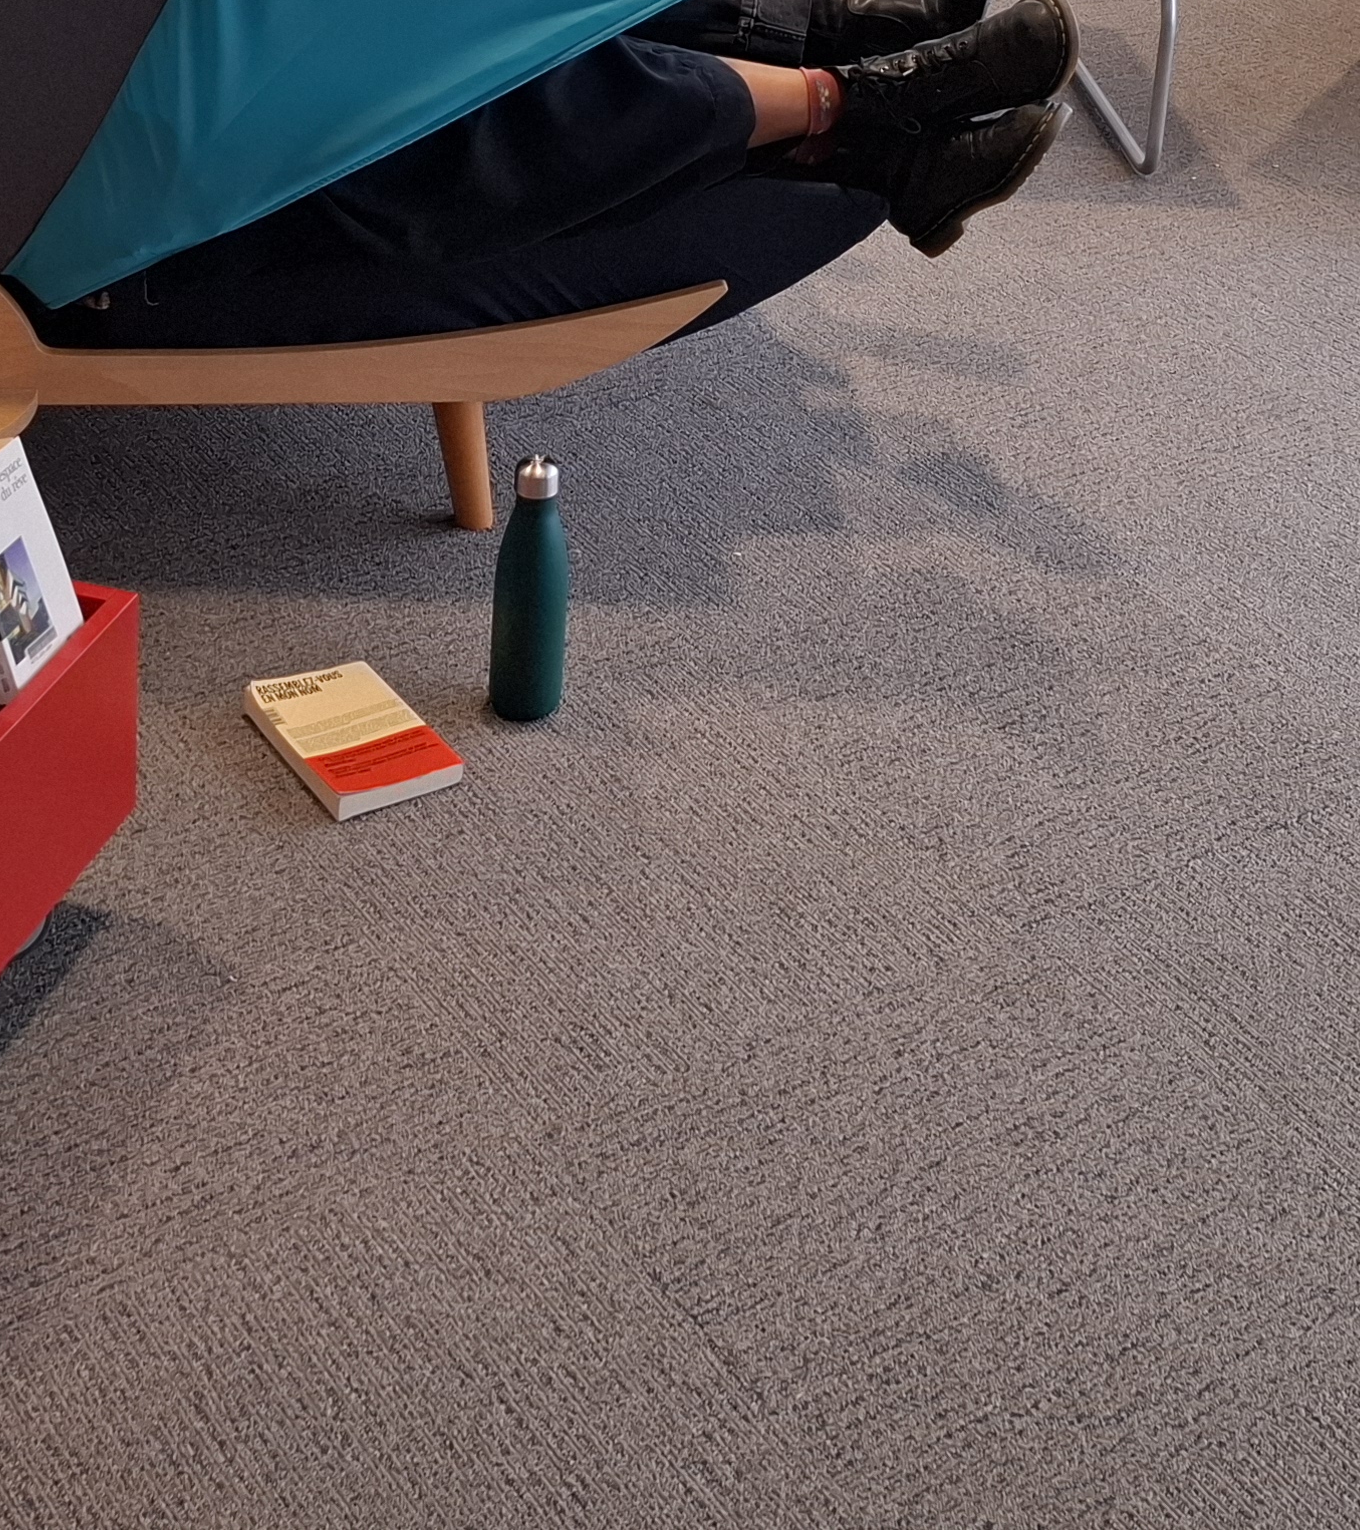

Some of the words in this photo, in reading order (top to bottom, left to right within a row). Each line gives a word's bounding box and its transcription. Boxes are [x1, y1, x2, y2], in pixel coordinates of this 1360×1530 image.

[0, 485, 13, 502] du
[11, 472, 29, 494] rêve
[255, 670, 343, 694] RASSEMBLEZ-VOUS
[260, 692, 276, 705] EN
[274, 687, 299, 701] MON
[298, 683, 323, 699] NOM
